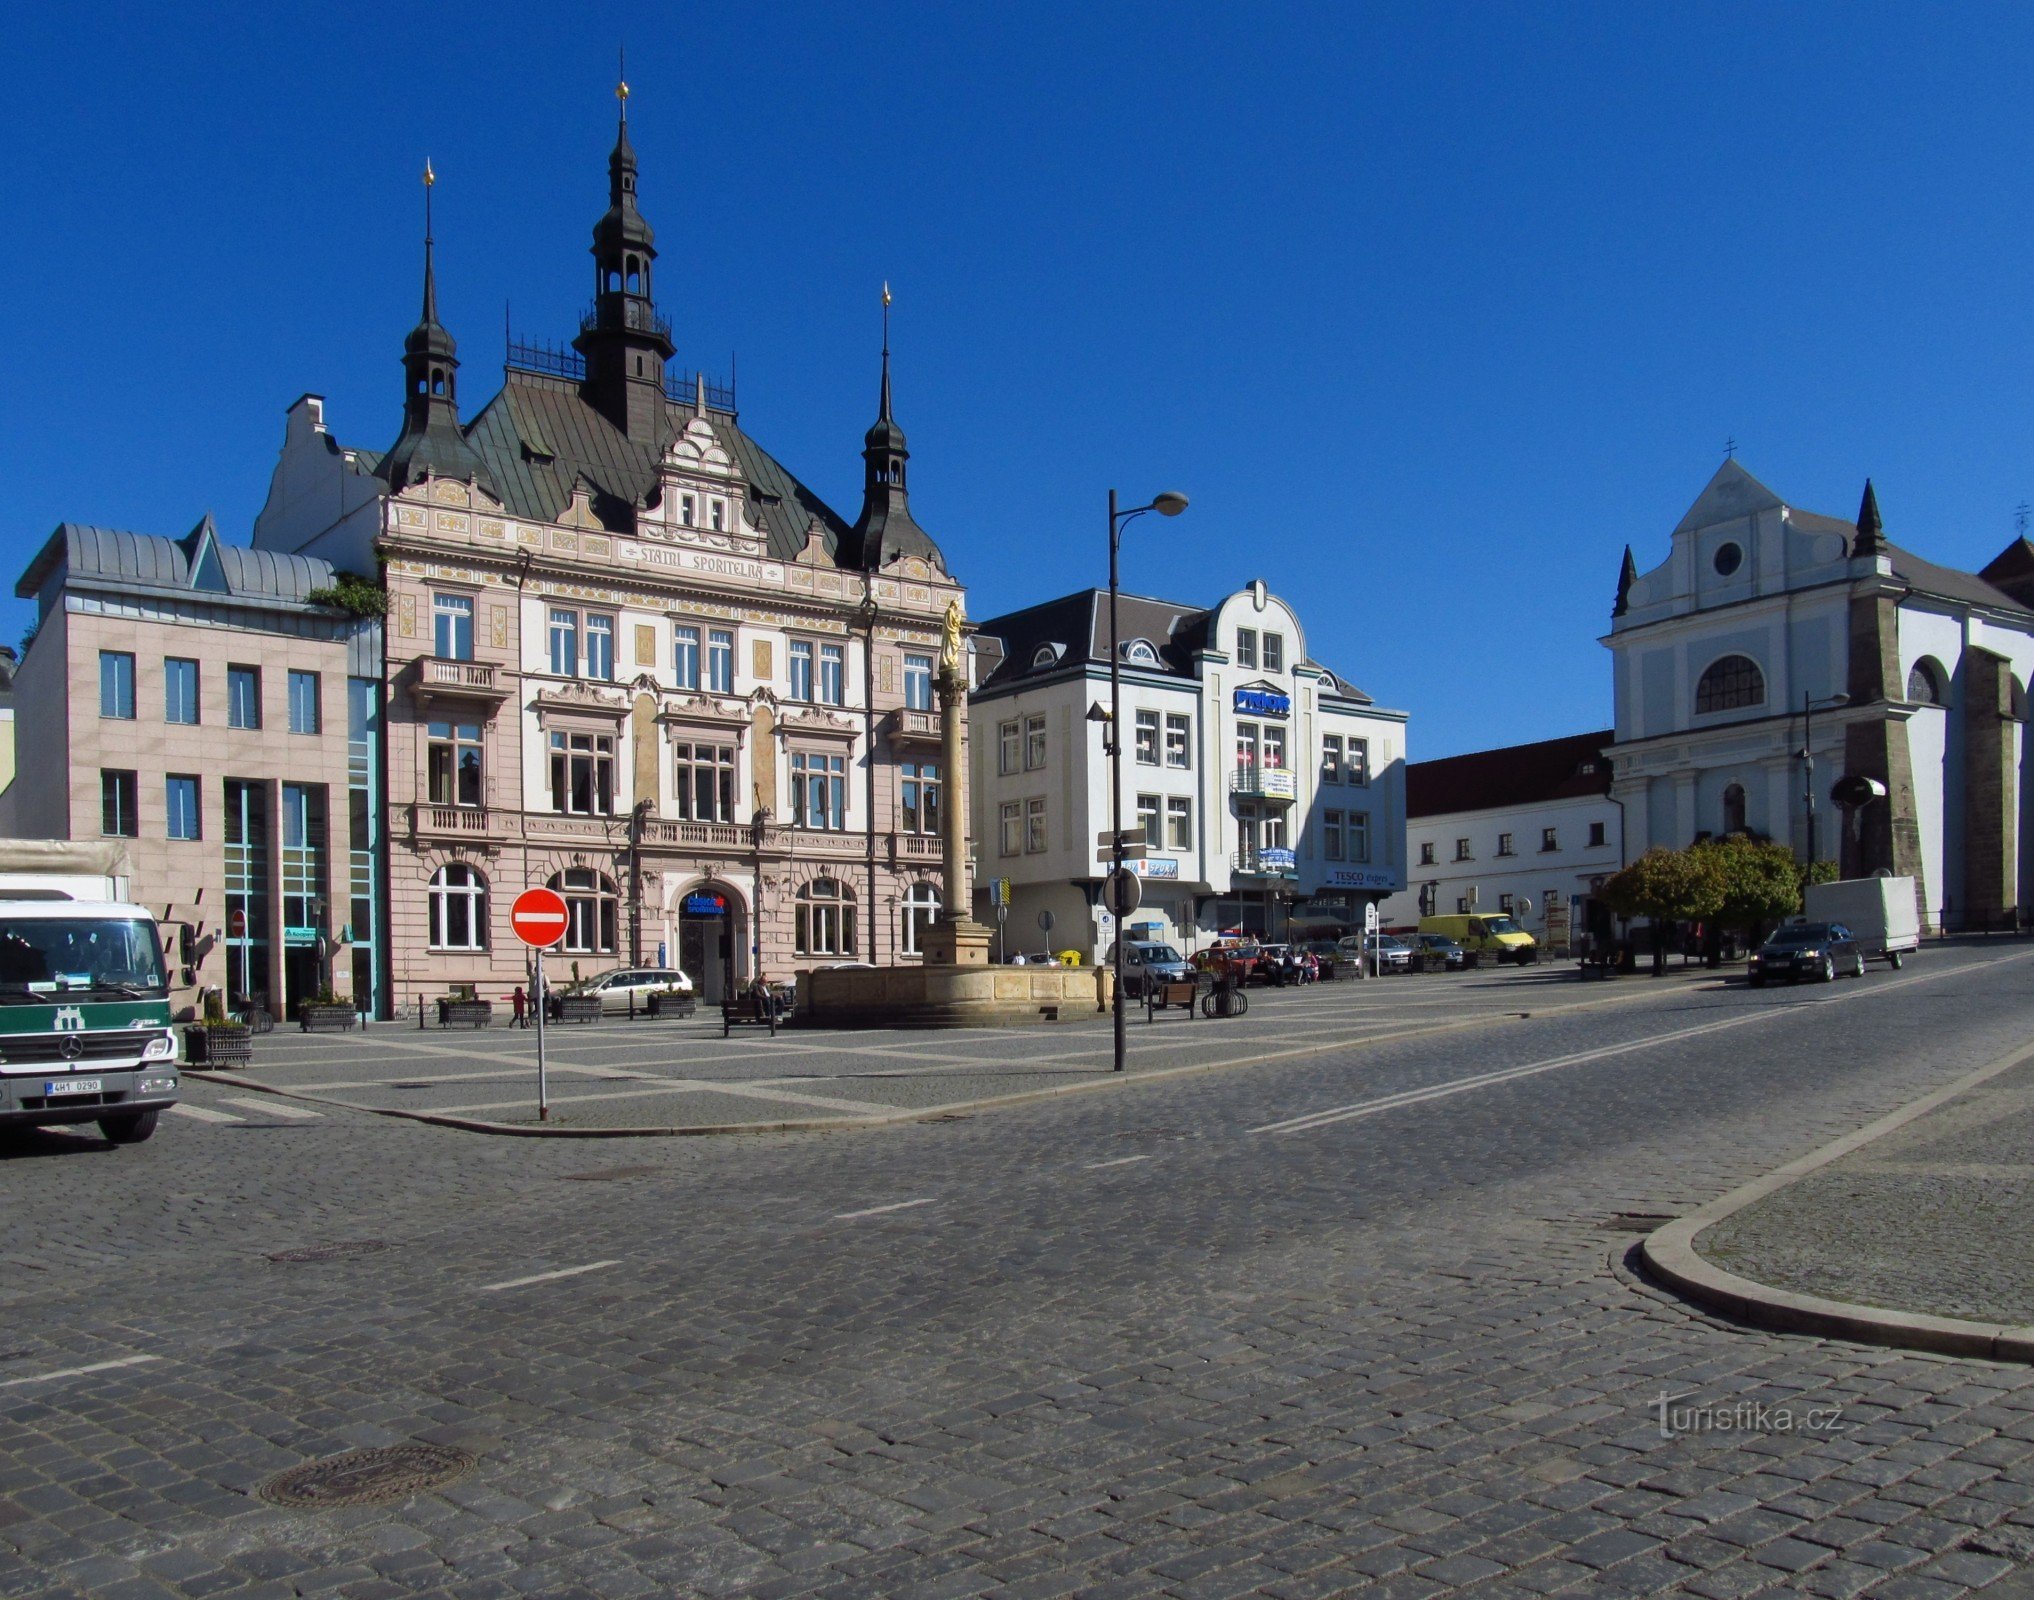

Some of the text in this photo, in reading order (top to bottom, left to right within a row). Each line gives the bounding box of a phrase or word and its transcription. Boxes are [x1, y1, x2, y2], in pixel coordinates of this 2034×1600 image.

[1236, 690, 1291, 713] PRIOR
[1108, 861, 1176, 873] HBBY SPORT
[1335, 871, 1364, 881] TESCO
[54, 1081, 98, 1091] 4H1 0290
